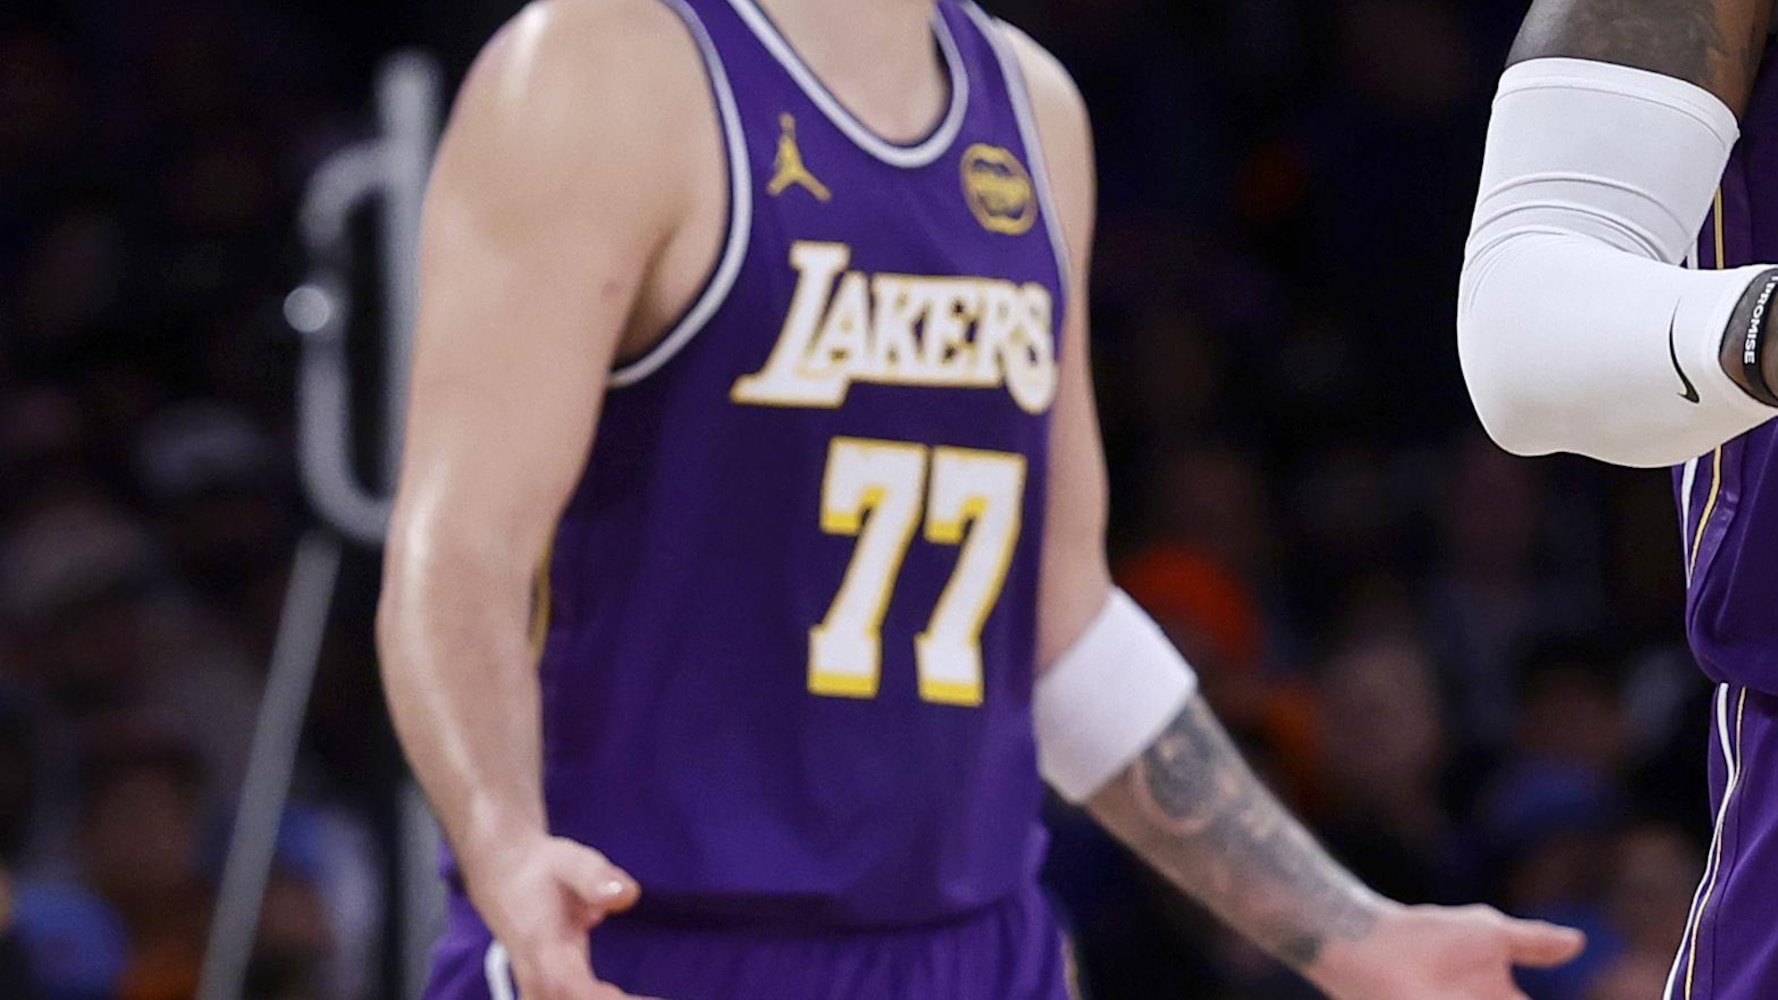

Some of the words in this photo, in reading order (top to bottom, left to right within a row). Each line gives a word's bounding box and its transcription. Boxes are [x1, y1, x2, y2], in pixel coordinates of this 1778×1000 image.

[729, 238, 1059, 415] LAKERS
[1744, 282, 1775, 364] PROMISE
[806, 434, 1028, 707] 77
